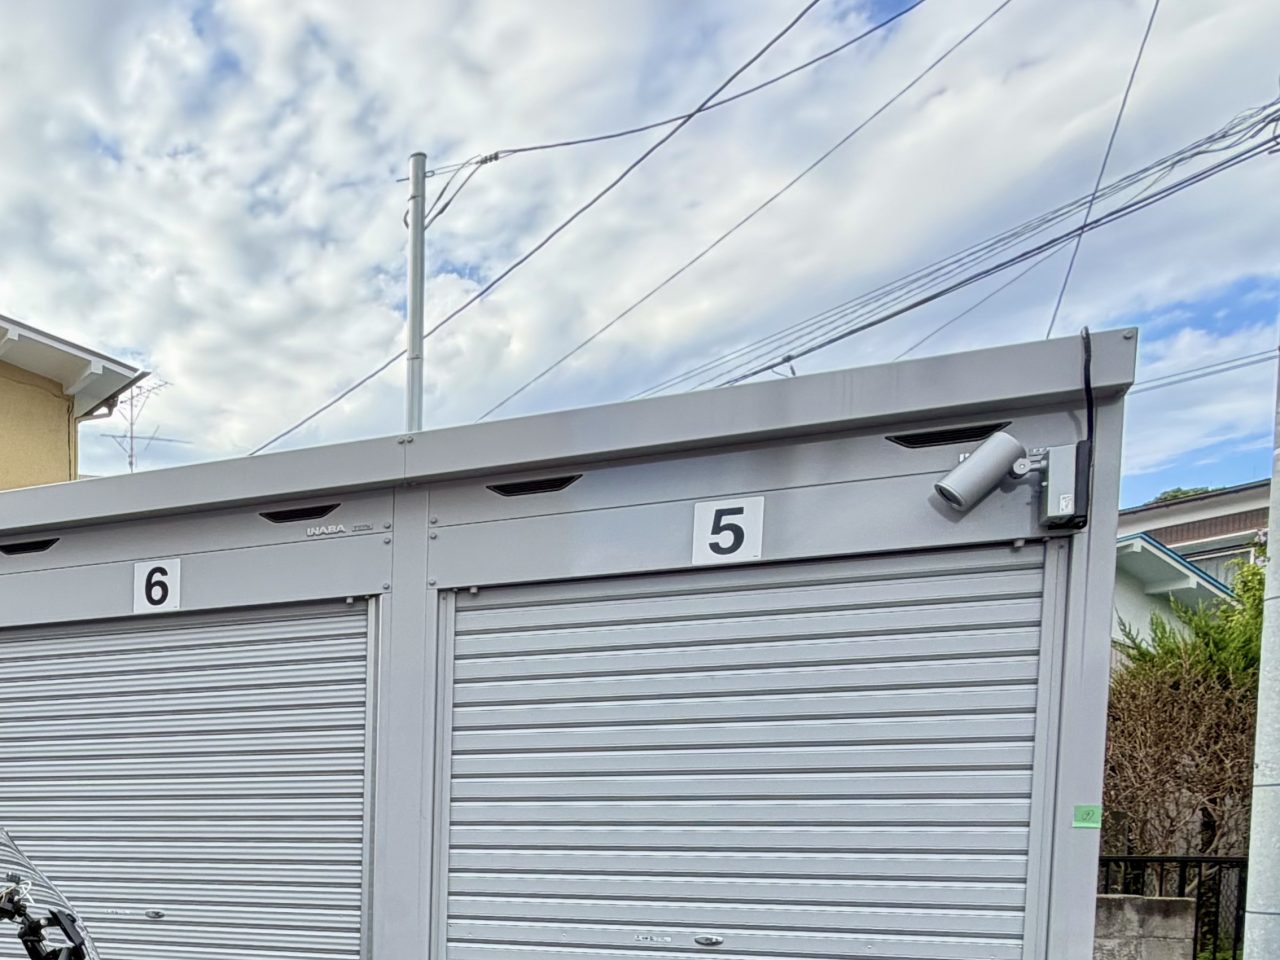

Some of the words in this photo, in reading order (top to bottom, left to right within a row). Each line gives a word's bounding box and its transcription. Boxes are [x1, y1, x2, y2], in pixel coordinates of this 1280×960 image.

[306, 524, 346, 537] INABA
[708, 506, 745, 555] 5
[144, 566, 169, 606] 6
